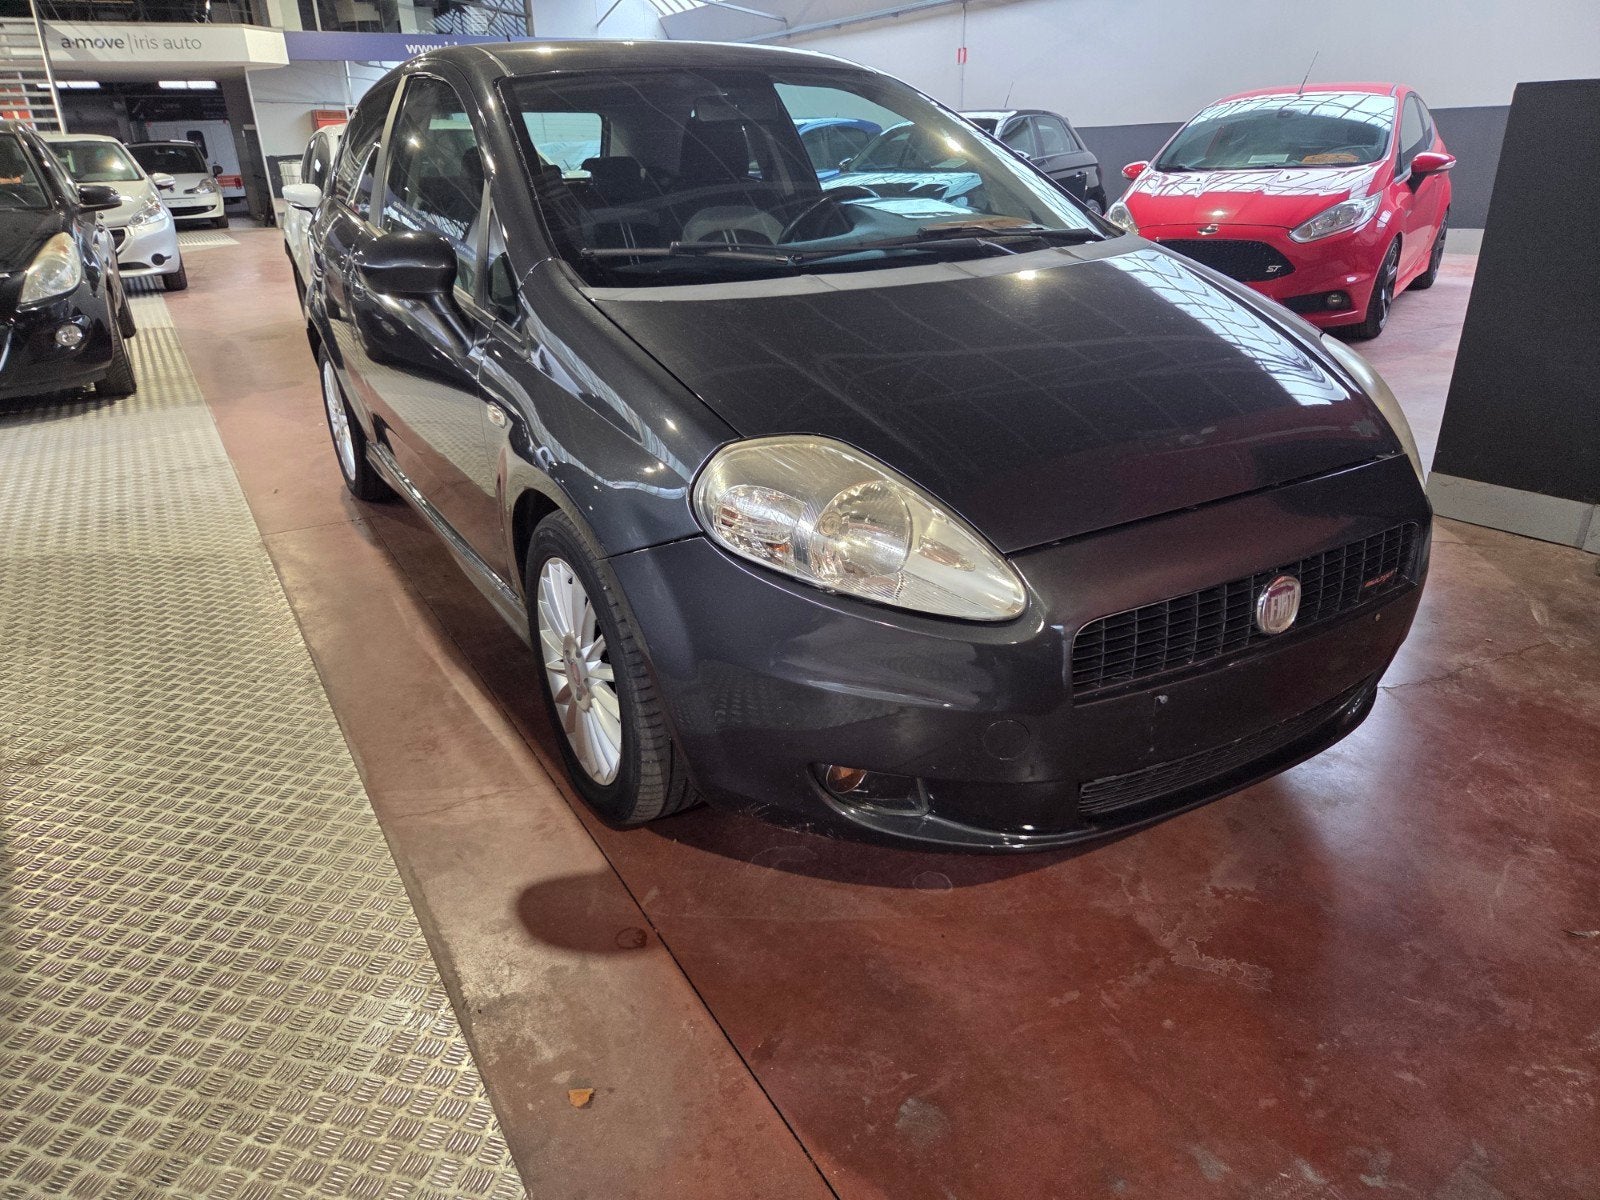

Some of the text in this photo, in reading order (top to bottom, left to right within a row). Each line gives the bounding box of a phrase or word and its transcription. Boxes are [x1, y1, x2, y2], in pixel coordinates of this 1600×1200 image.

[134, 36, 159, 49] iris
[163, 37, 202, 50] auto
[1265, 265, 1282, 273] ST
[1269, 588, 1296, 621] FIAT
